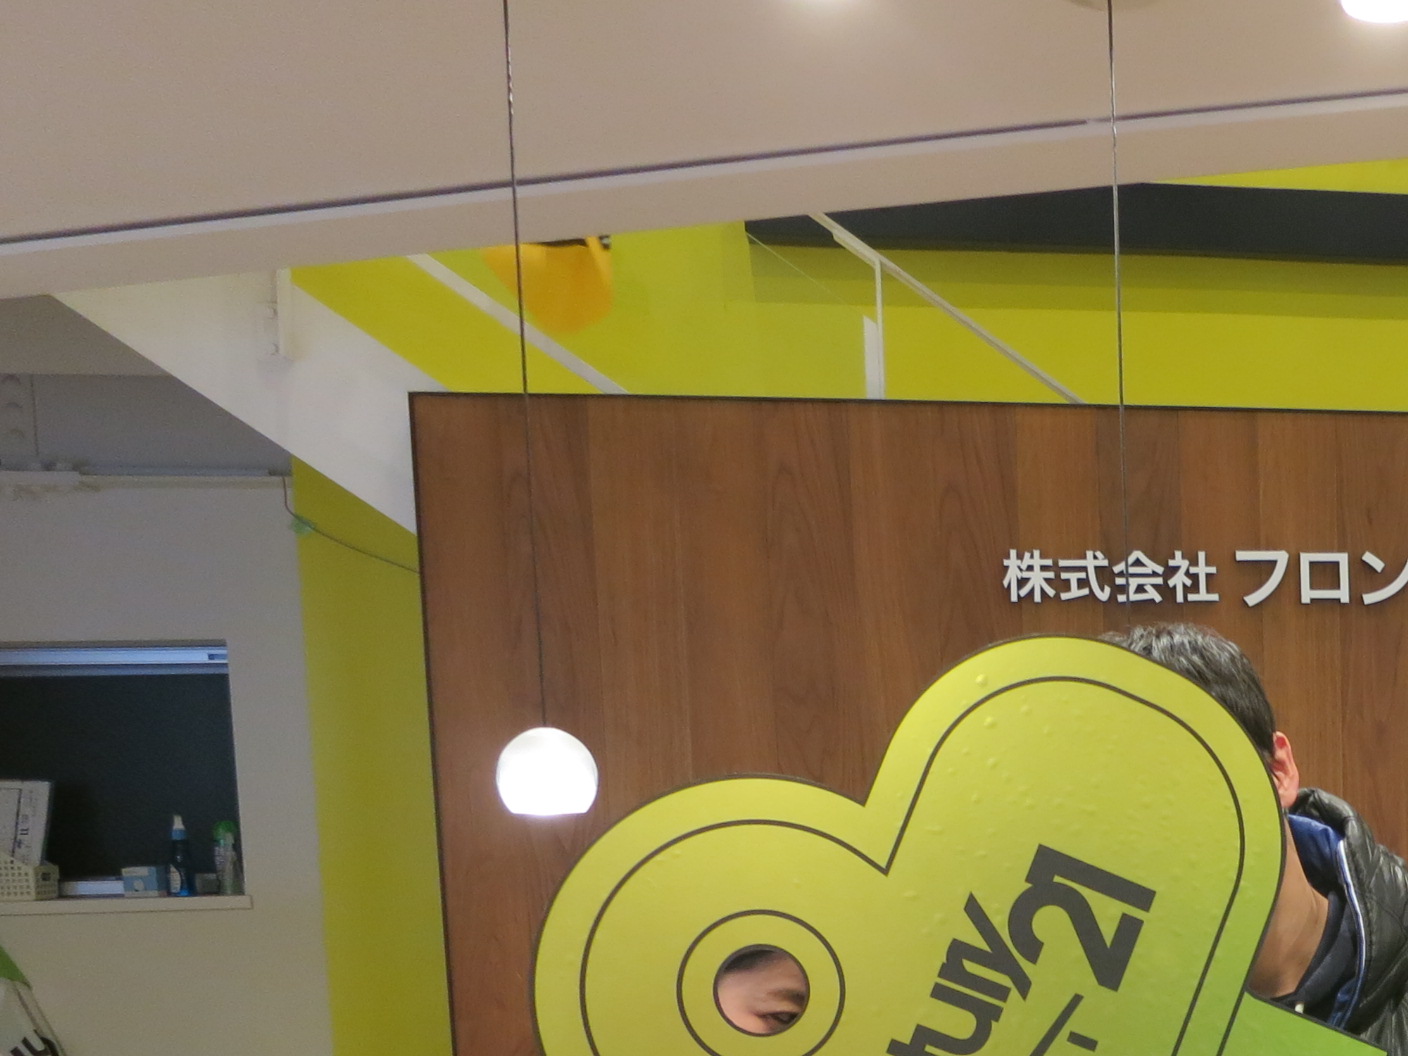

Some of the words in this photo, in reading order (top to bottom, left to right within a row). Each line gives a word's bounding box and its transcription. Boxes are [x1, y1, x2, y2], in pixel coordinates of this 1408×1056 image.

[1002, 547, 1219, 603] 株式会社
[1008, 844, 1157, 992] 21
